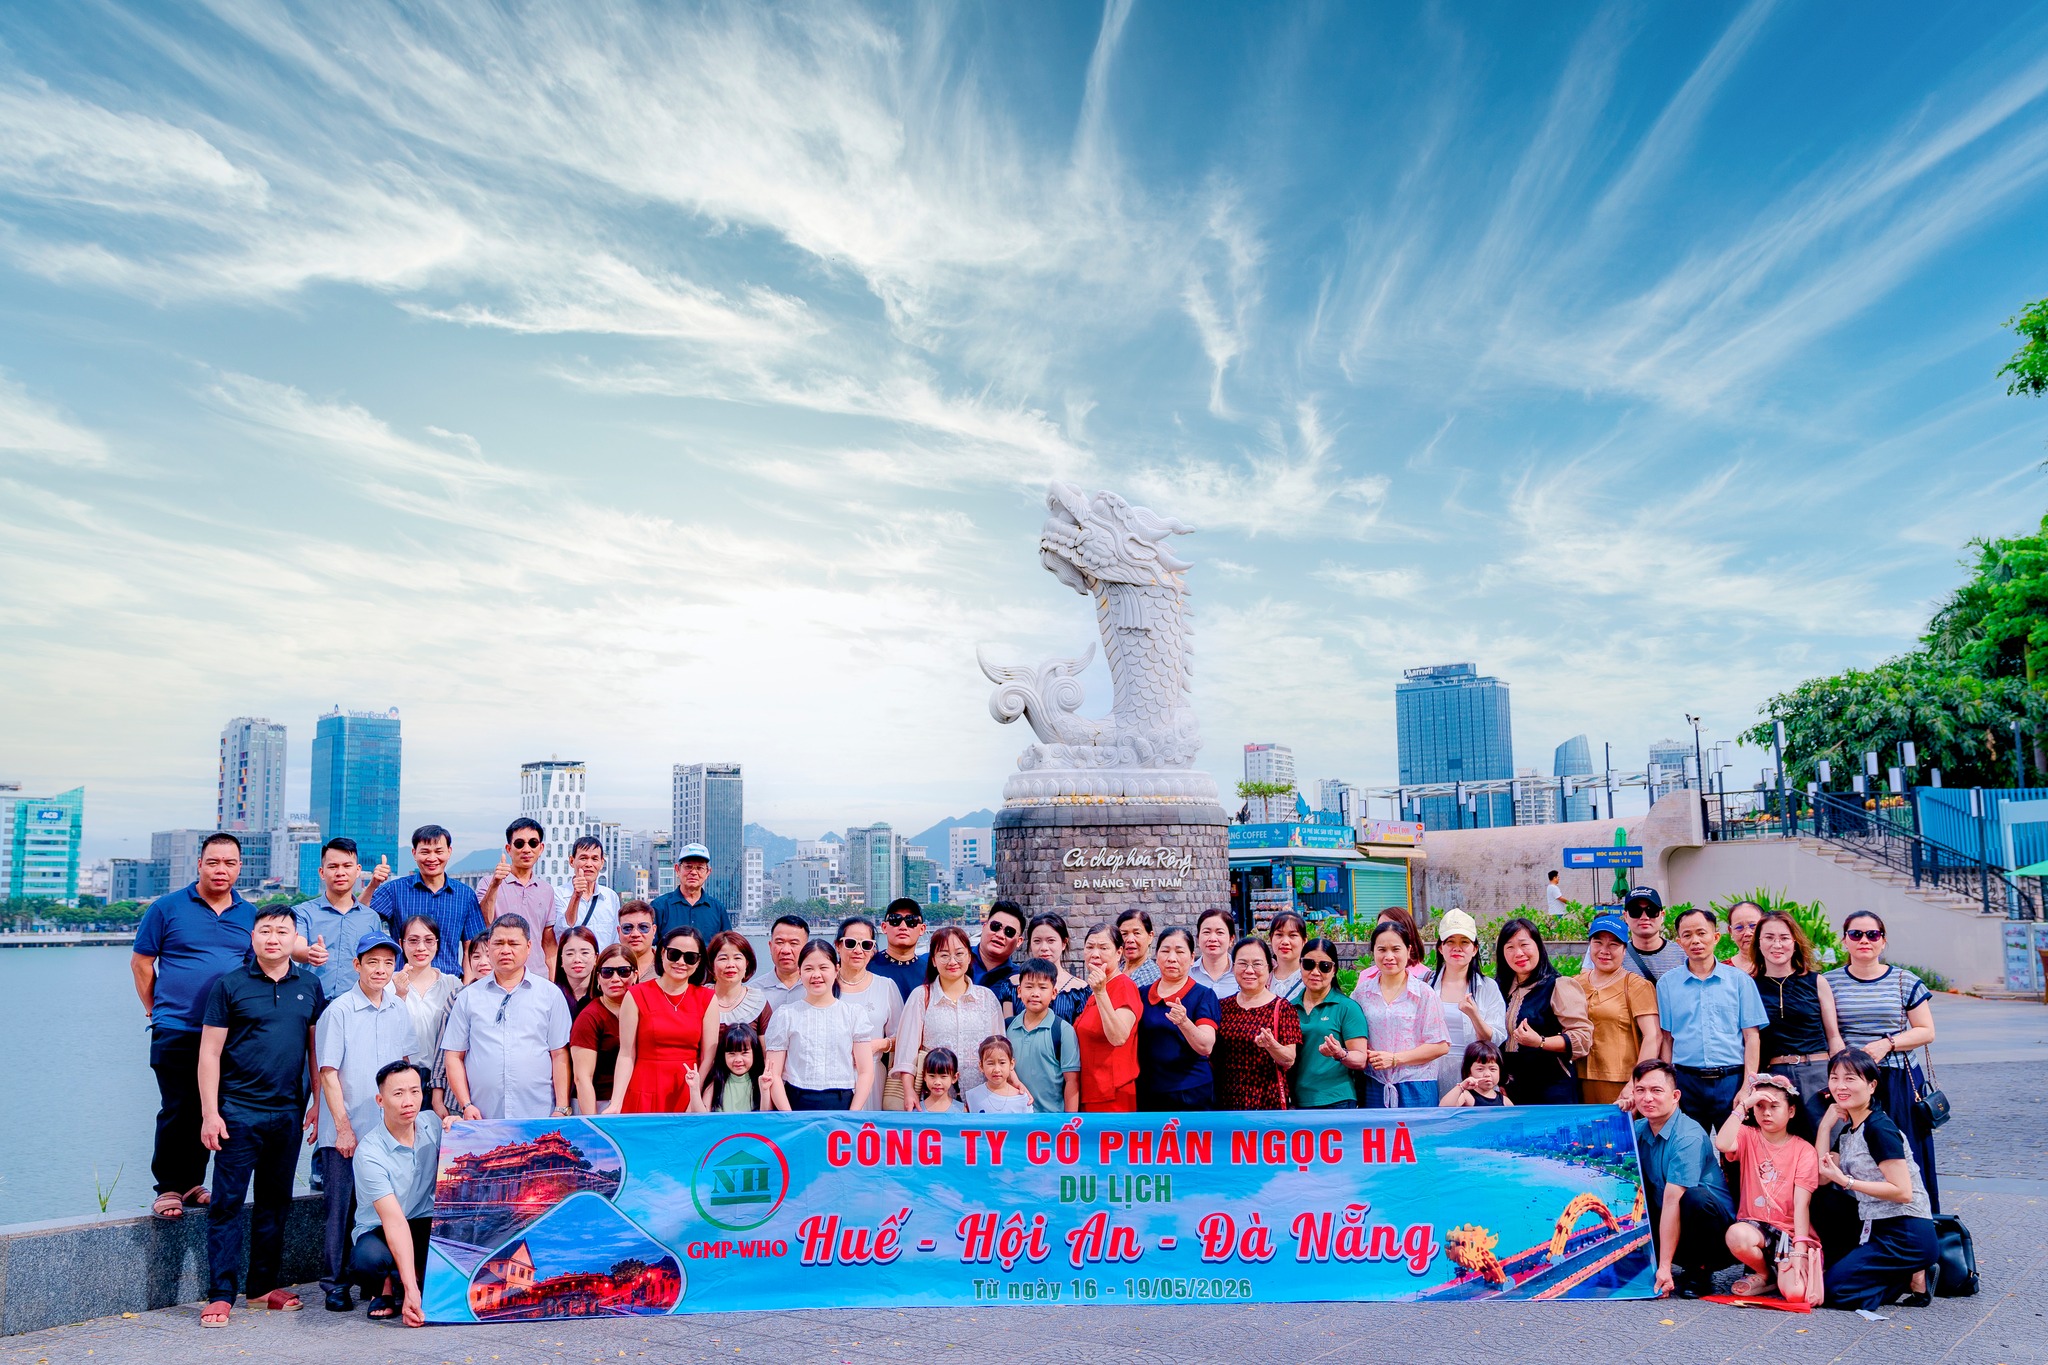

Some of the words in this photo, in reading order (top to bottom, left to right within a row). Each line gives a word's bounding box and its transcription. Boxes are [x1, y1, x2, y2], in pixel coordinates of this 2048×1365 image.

[348, 709, 389, 719] VietinBank
[1242, 831, 1267, 839] COFFEE
[1063, 847, 1088, 867] Cá
[1090, 847, 1125, 873] chép
[1126, 847, 1154, 867] hóa
[1155, 847, 1192, 877] Rồng
[1073, 876, 1090, 888] ĐÀ
[1092, 875, 1124, 888] NẴNG
[1132, 876, 1156, 890] VIỆT
[1158, 877, 1182, 888] NAM
[827, 1123, 942, 1167] CÔNG
[960, 1130, 1007, 1165] TY
[1027, 1118, 1082, 1165] CỔ
[1100, 1119, 1212, 1164] PHẦN
[1231, 1129, 1343, 1172] NGỌC
[1363, 1121, 1416, 1163] HÀ
[711, 1166, 770, 1194] NH
[1059, 1176, 1096, 1202] DU
[1109, 1176, 1171, 1208] LỊCH
[687, 1239, 788, 1259] GMP-WHO
[798, 1207, 908, 1262] Huế
[958, 1213, 1048, 1268] Hội
[1067, 1213, 1141, 1264] An
[1198, 1212, 1271, 1258] Đà
[1291, 1203, 1432, 1271] Nẵng
[974, 1278, 1000, 1299] Từ
[1008, 1279, 1062, 1301] ngày
[1071, 1279, 1097, 1299] 16
[1124, 1278, 1253, 1299] 19/05/2026
